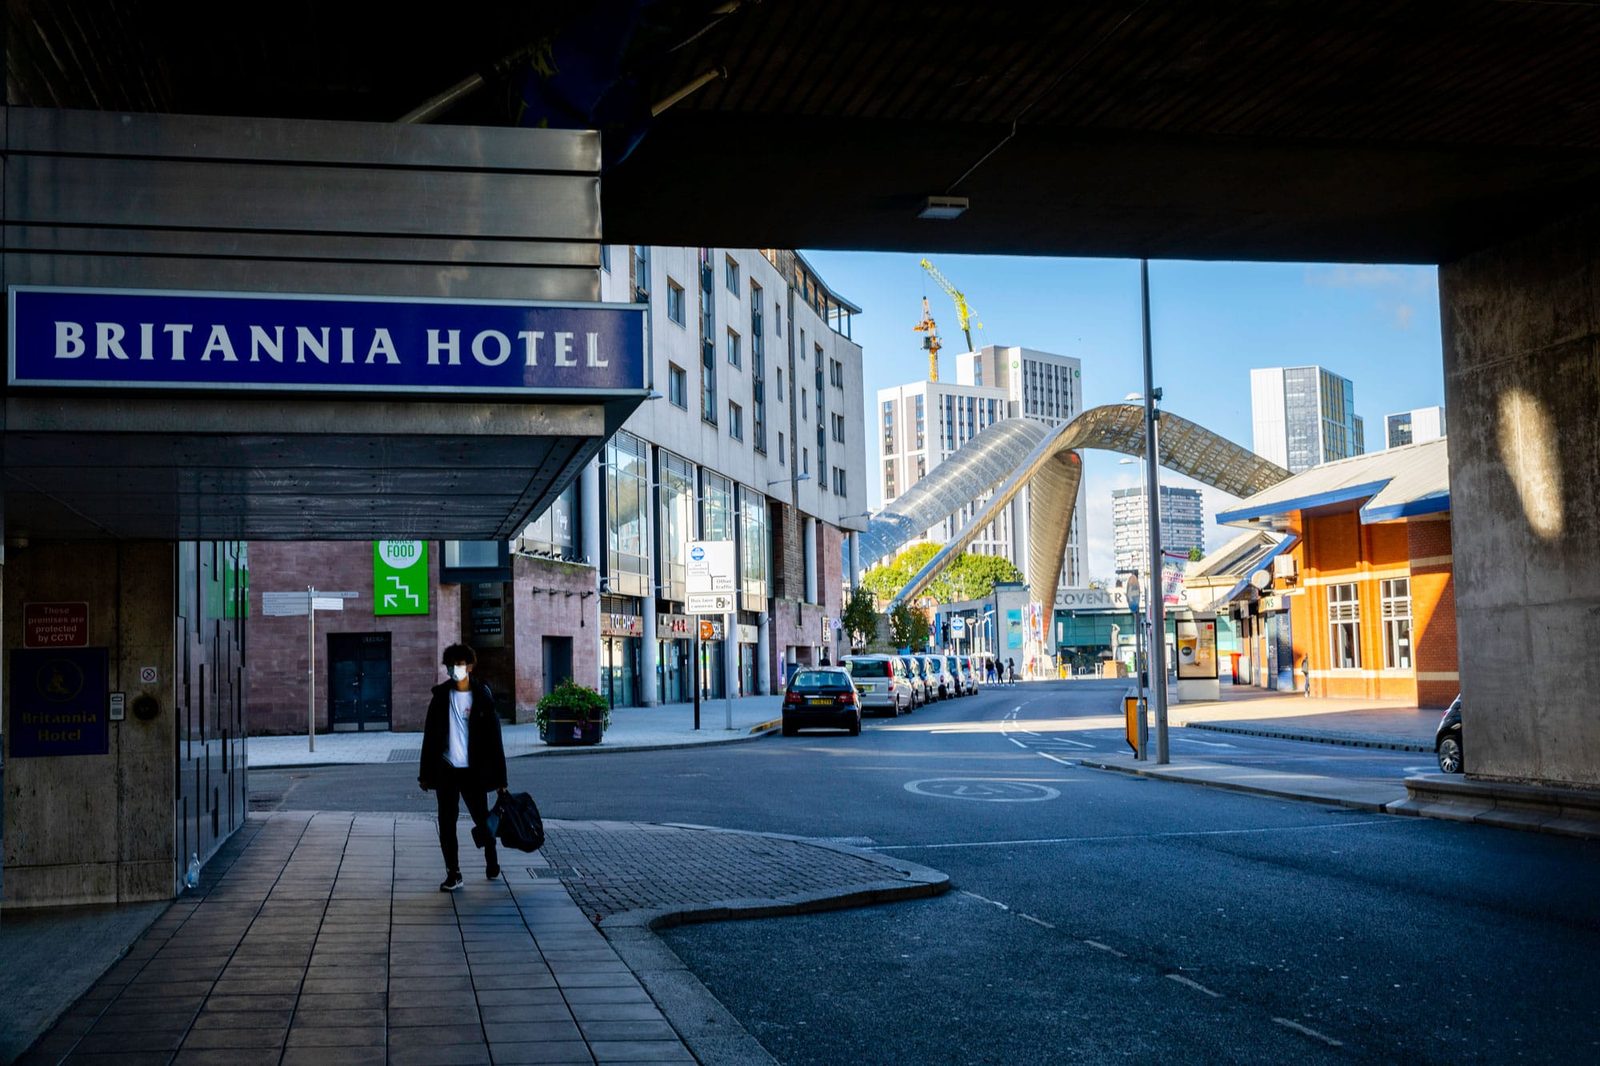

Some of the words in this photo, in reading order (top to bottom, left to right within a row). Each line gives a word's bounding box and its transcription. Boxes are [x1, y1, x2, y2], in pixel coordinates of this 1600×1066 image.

[53, 320, 401, 366] BRITANNIA
[426, 328, 610, 369] HOTEL
[387, 544, 415, 558] FOOD
[1055, 591, 1123, 605] COVENTR
[43, 606, 70, 614] These
[28, 616, 68, 625] premises
[35, 624, 77, 634] protected
[38, 634, 49, 643] by
[50, 634, 75, 642] CCTV
[21, 711, 97, 725] Britannia
[37, 728, 81, 743] Hotel
